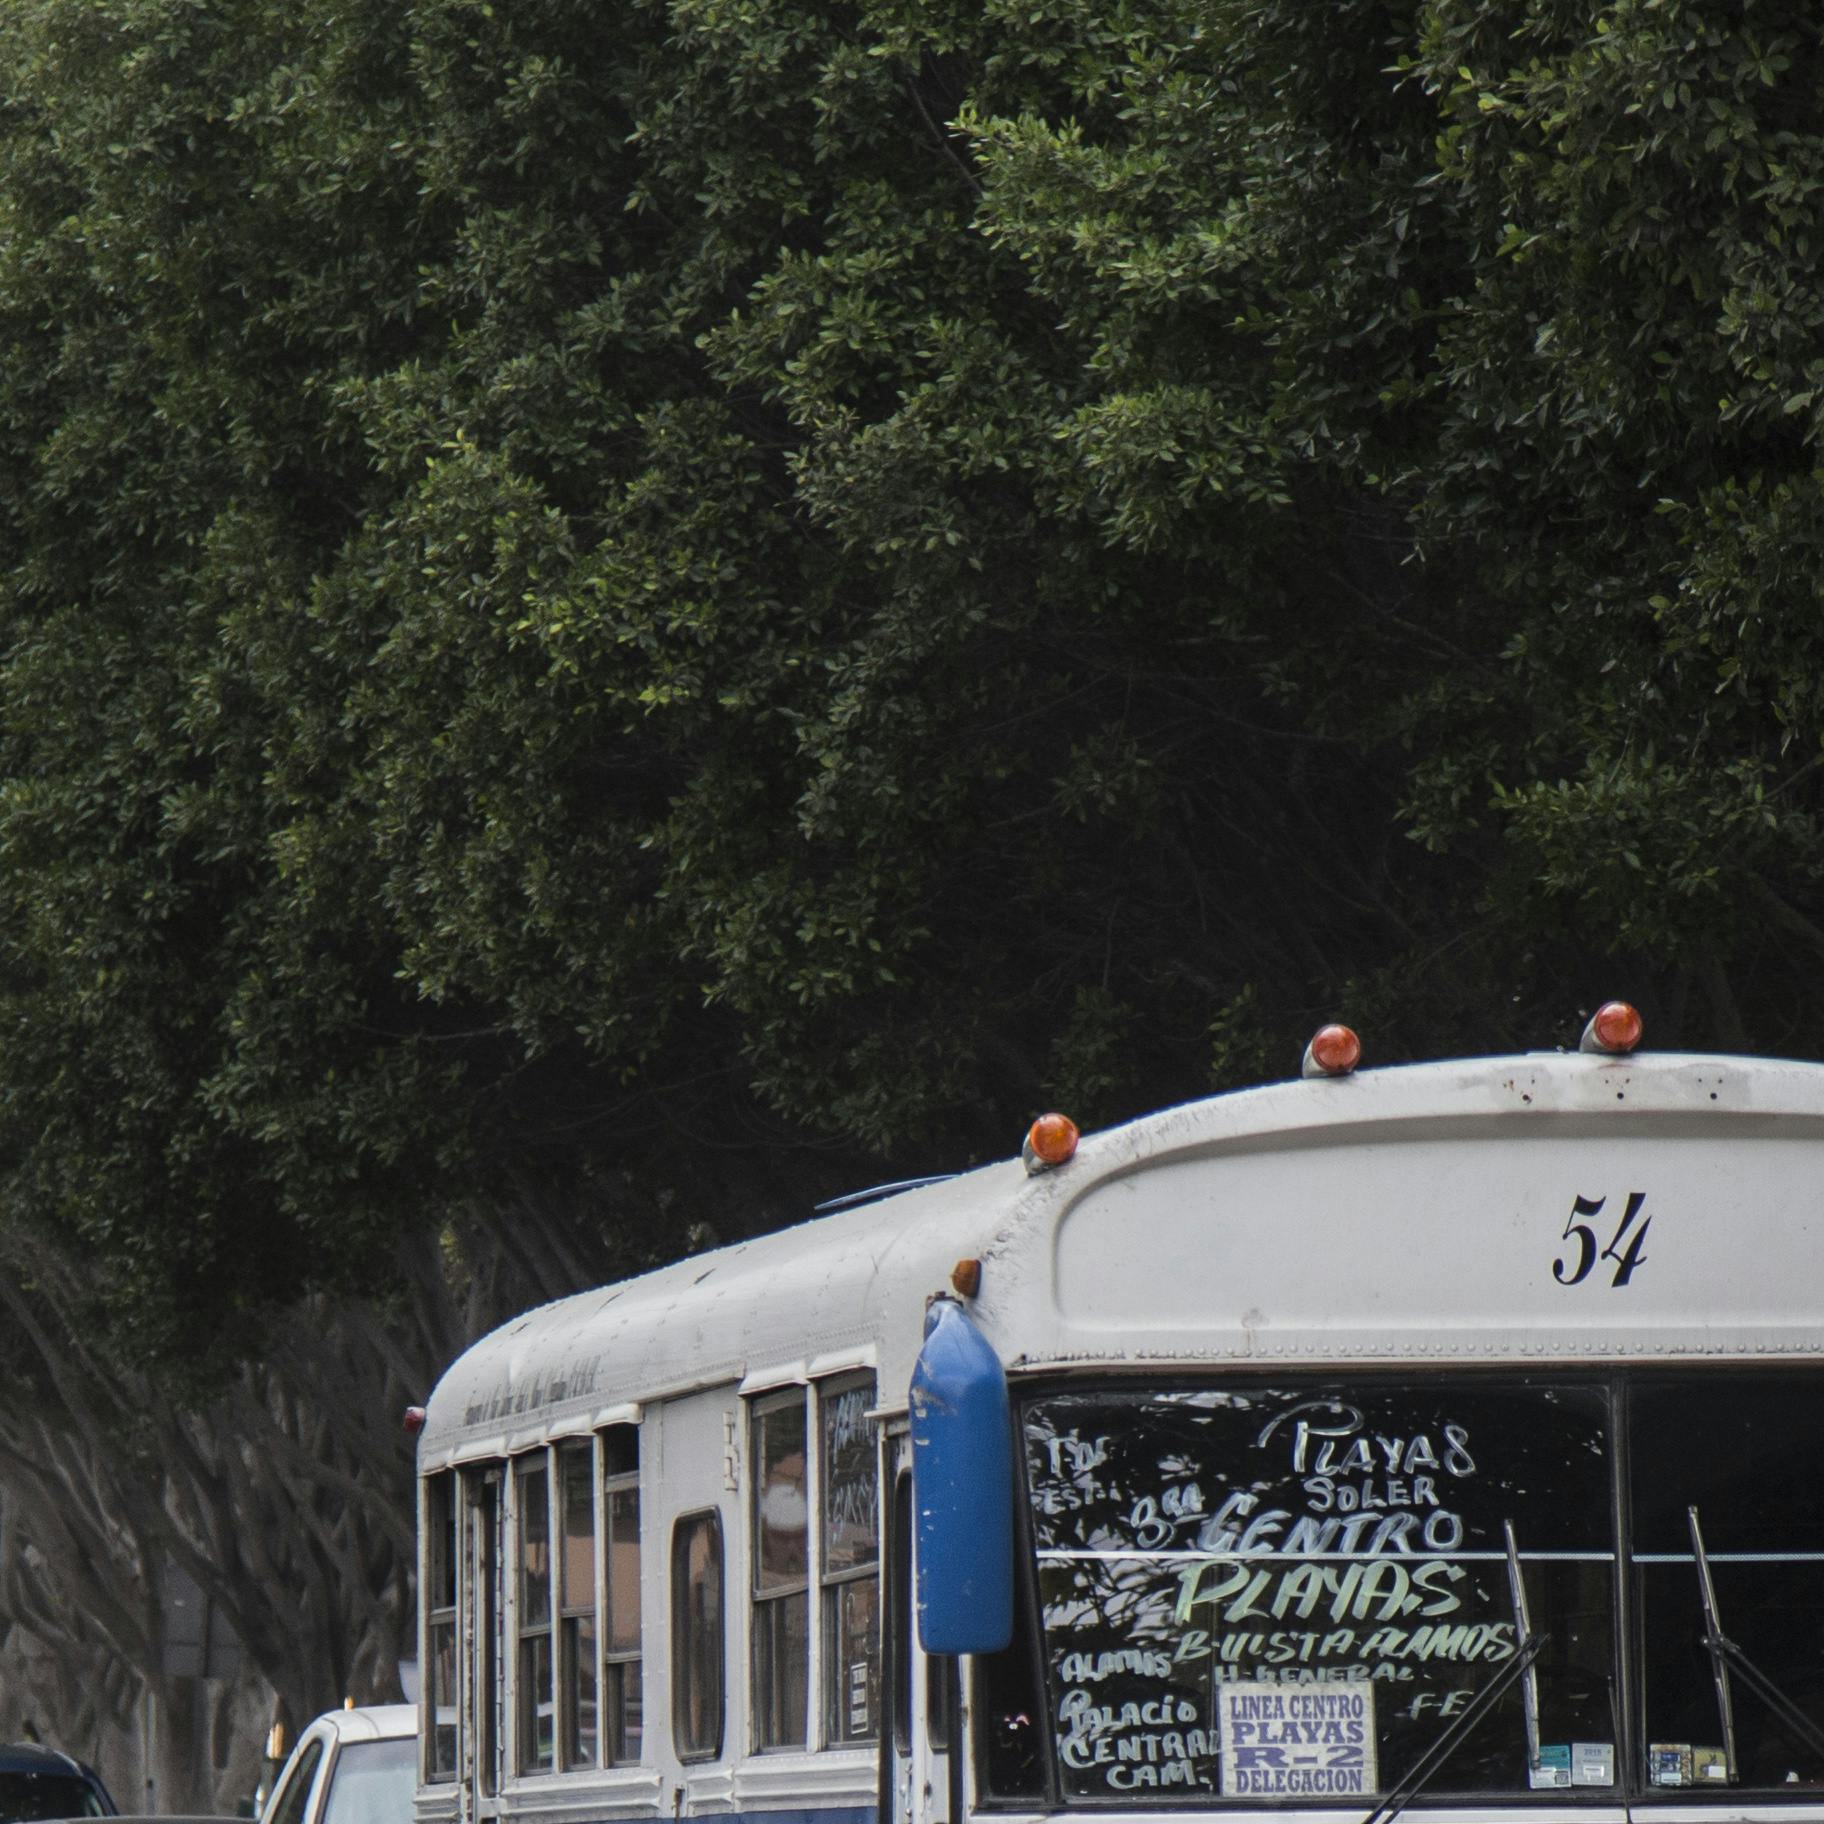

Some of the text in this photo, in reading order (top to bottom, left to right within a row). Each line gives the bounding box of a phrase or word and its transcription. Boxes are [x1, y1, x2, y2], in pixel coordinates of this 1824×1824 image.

[1552, 1191, 1653, 1289] 54
[1258, 1401, 1476, 1477] PLAYAS
[1302, 1476, 1439, 1512] SOLER
[1197, 1492, 1463, 1554] CENTRO
[1175, 1560, 1466, 1623] PLAYAS
[1230, 1694, 1364, 1720] LINEA CENTRO
[1232, 1721, 1365, 1744] PLAYAS
[1233, 1745, 1365, 1768] R-2
[1236, 1768, 1363, 1793] DELEGACION
